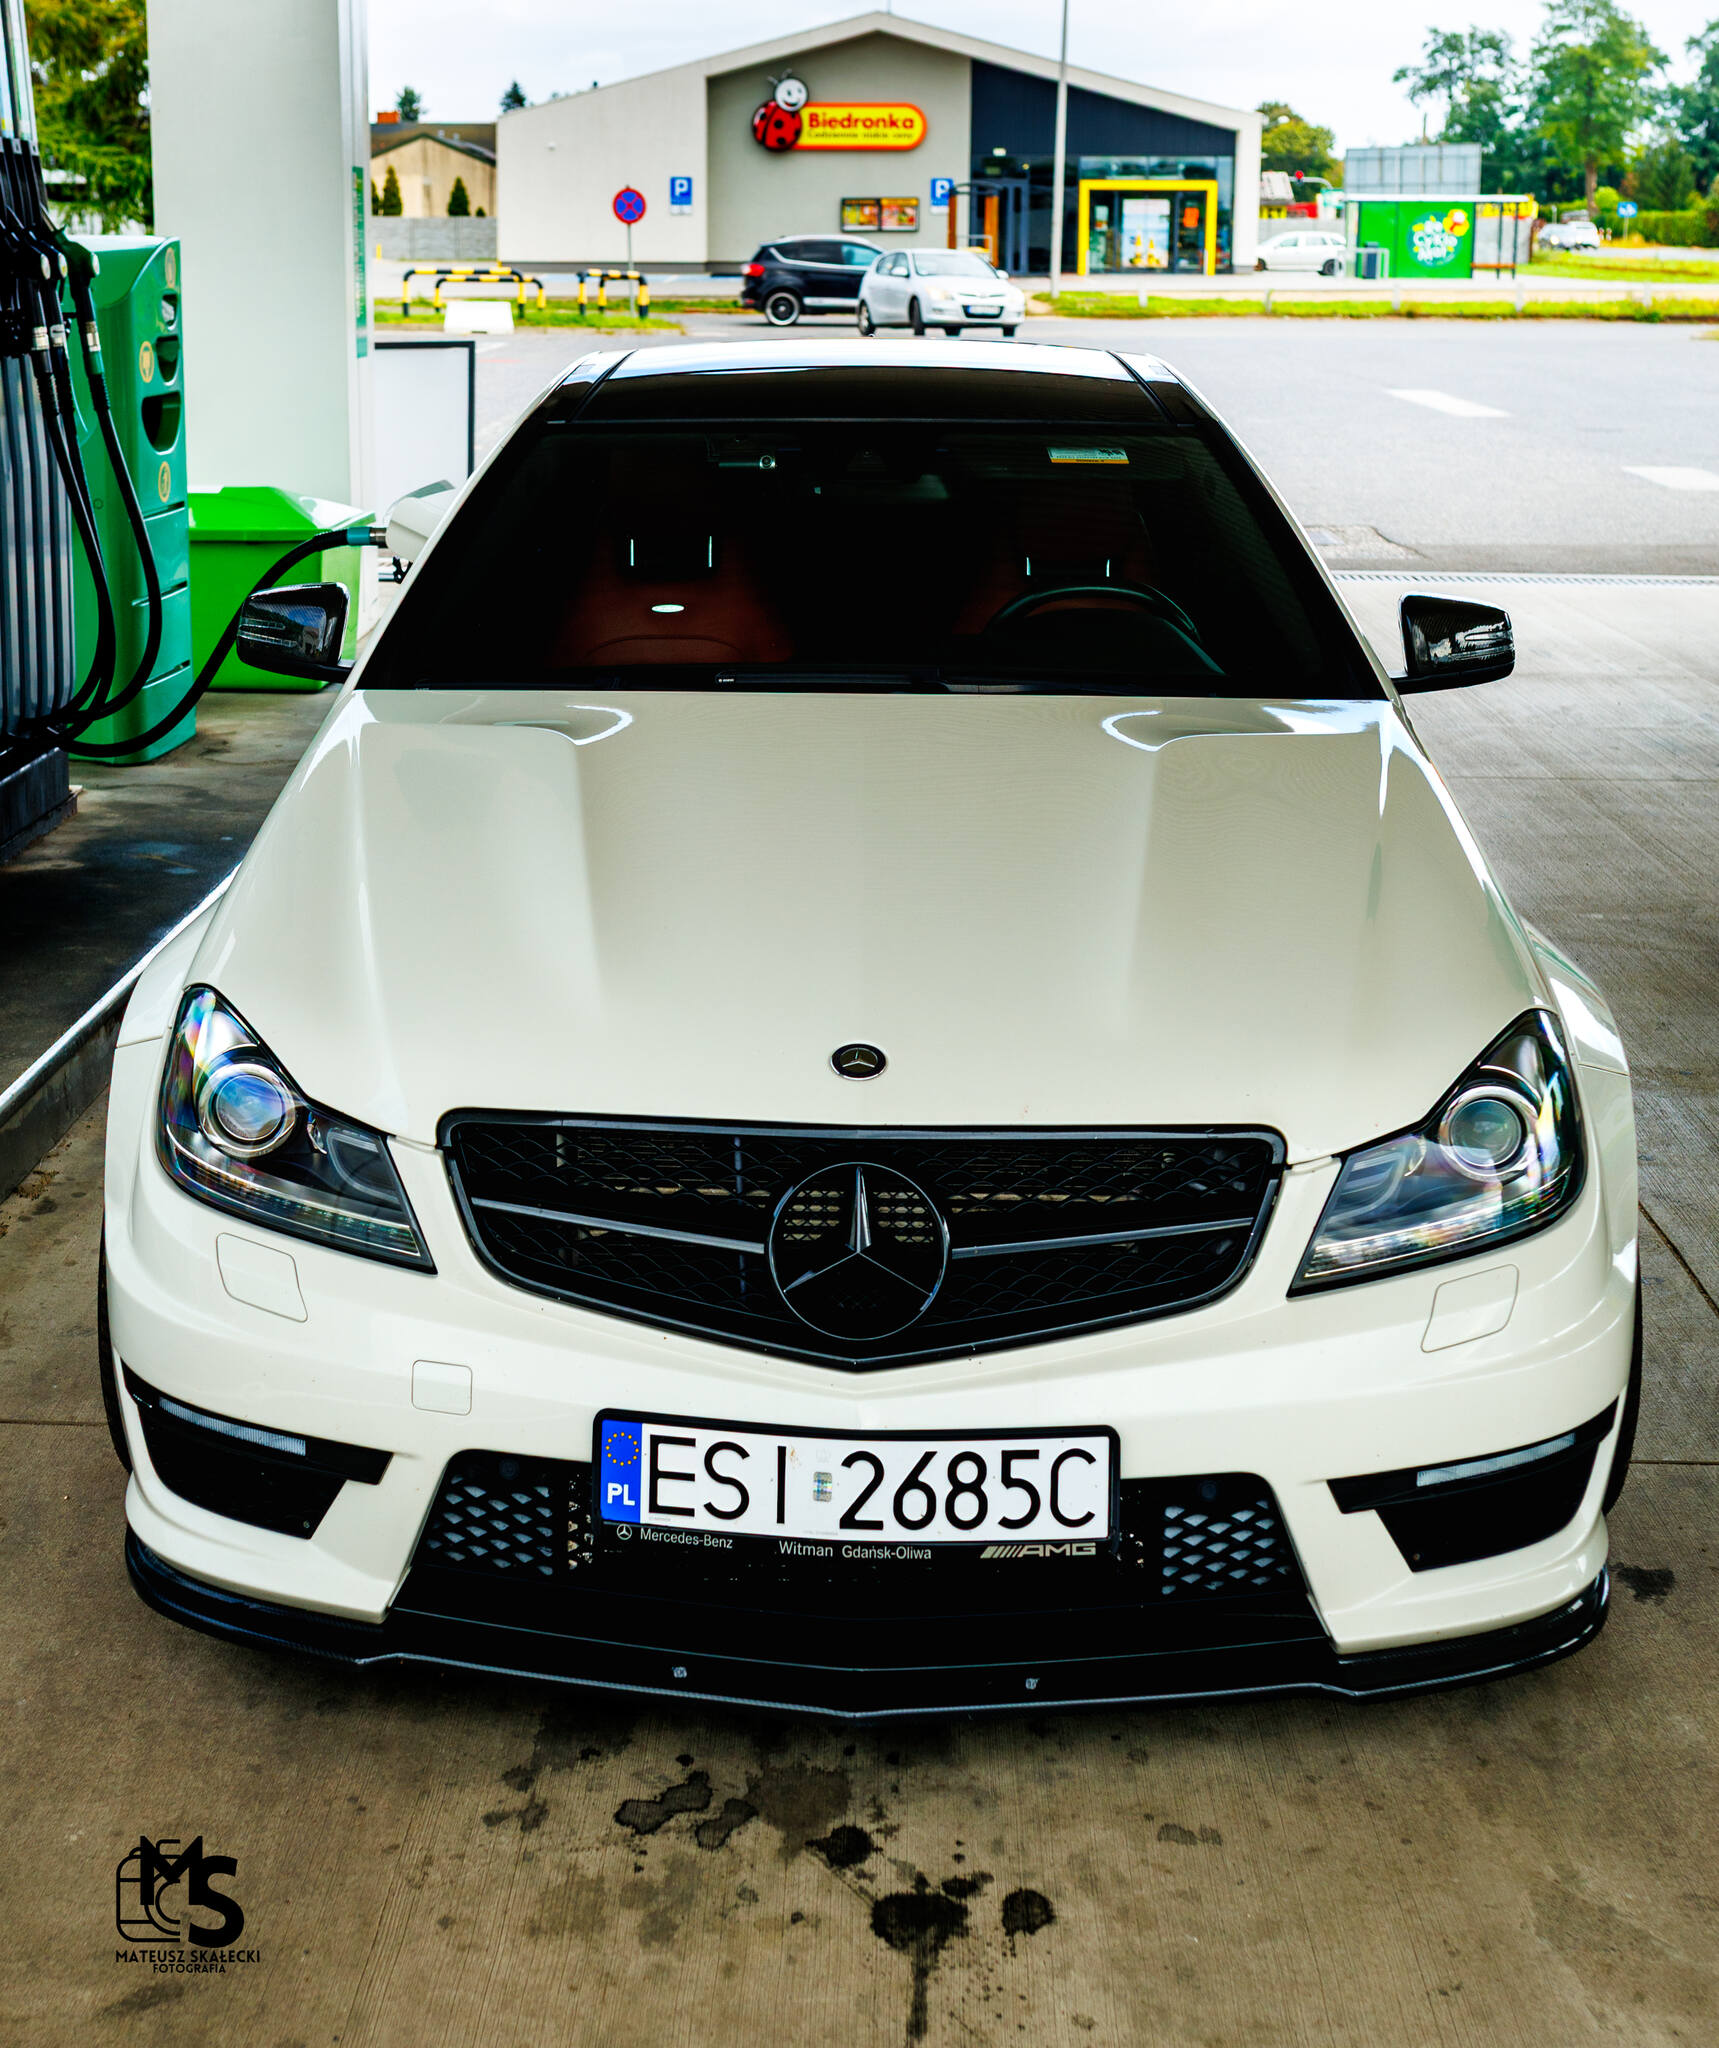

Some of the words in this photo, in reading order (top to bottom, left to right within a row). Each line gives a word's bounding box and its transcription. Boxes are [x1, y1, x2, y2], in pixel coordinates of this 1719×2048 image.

[808, 111, 915, 129] Biedronka
[674, 179, 689, 197] P
[935, 179, 950, 198] P
[648, 1433, 787, 1525] ESI
[838, 1447, 1097, 1531] 2685C
[606, 1482, 636, 1506] PL
[639, 1527, 734, 1550] Mercedes-Benz
[778, 1540, 834, 1558] Witman
[841, 1544, 932, 1560] Gdańsk-Oliwa
[1017, 1542, 1097, 1558] AMG
